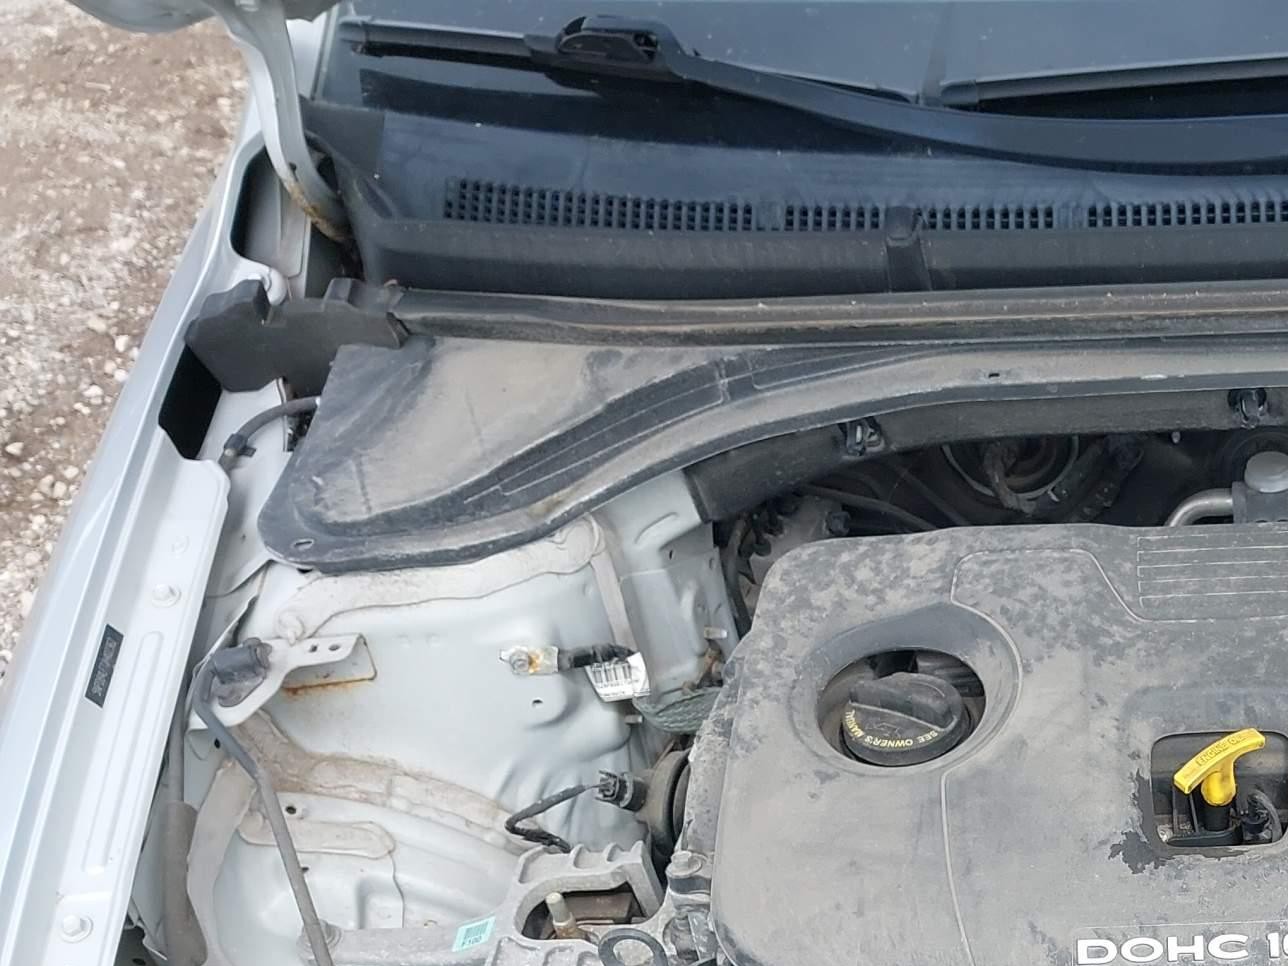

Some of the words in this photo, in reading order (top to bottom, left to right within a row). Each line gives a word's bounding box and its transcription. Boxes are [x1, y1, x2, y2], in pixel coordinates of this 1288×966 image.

[845, 709, 865, 738] MANUAL
[864, 735, 914, 748] OWNER'S
[917, 730, 938, 744] SEE
[1076, 934, 1250, 966] DOHC
